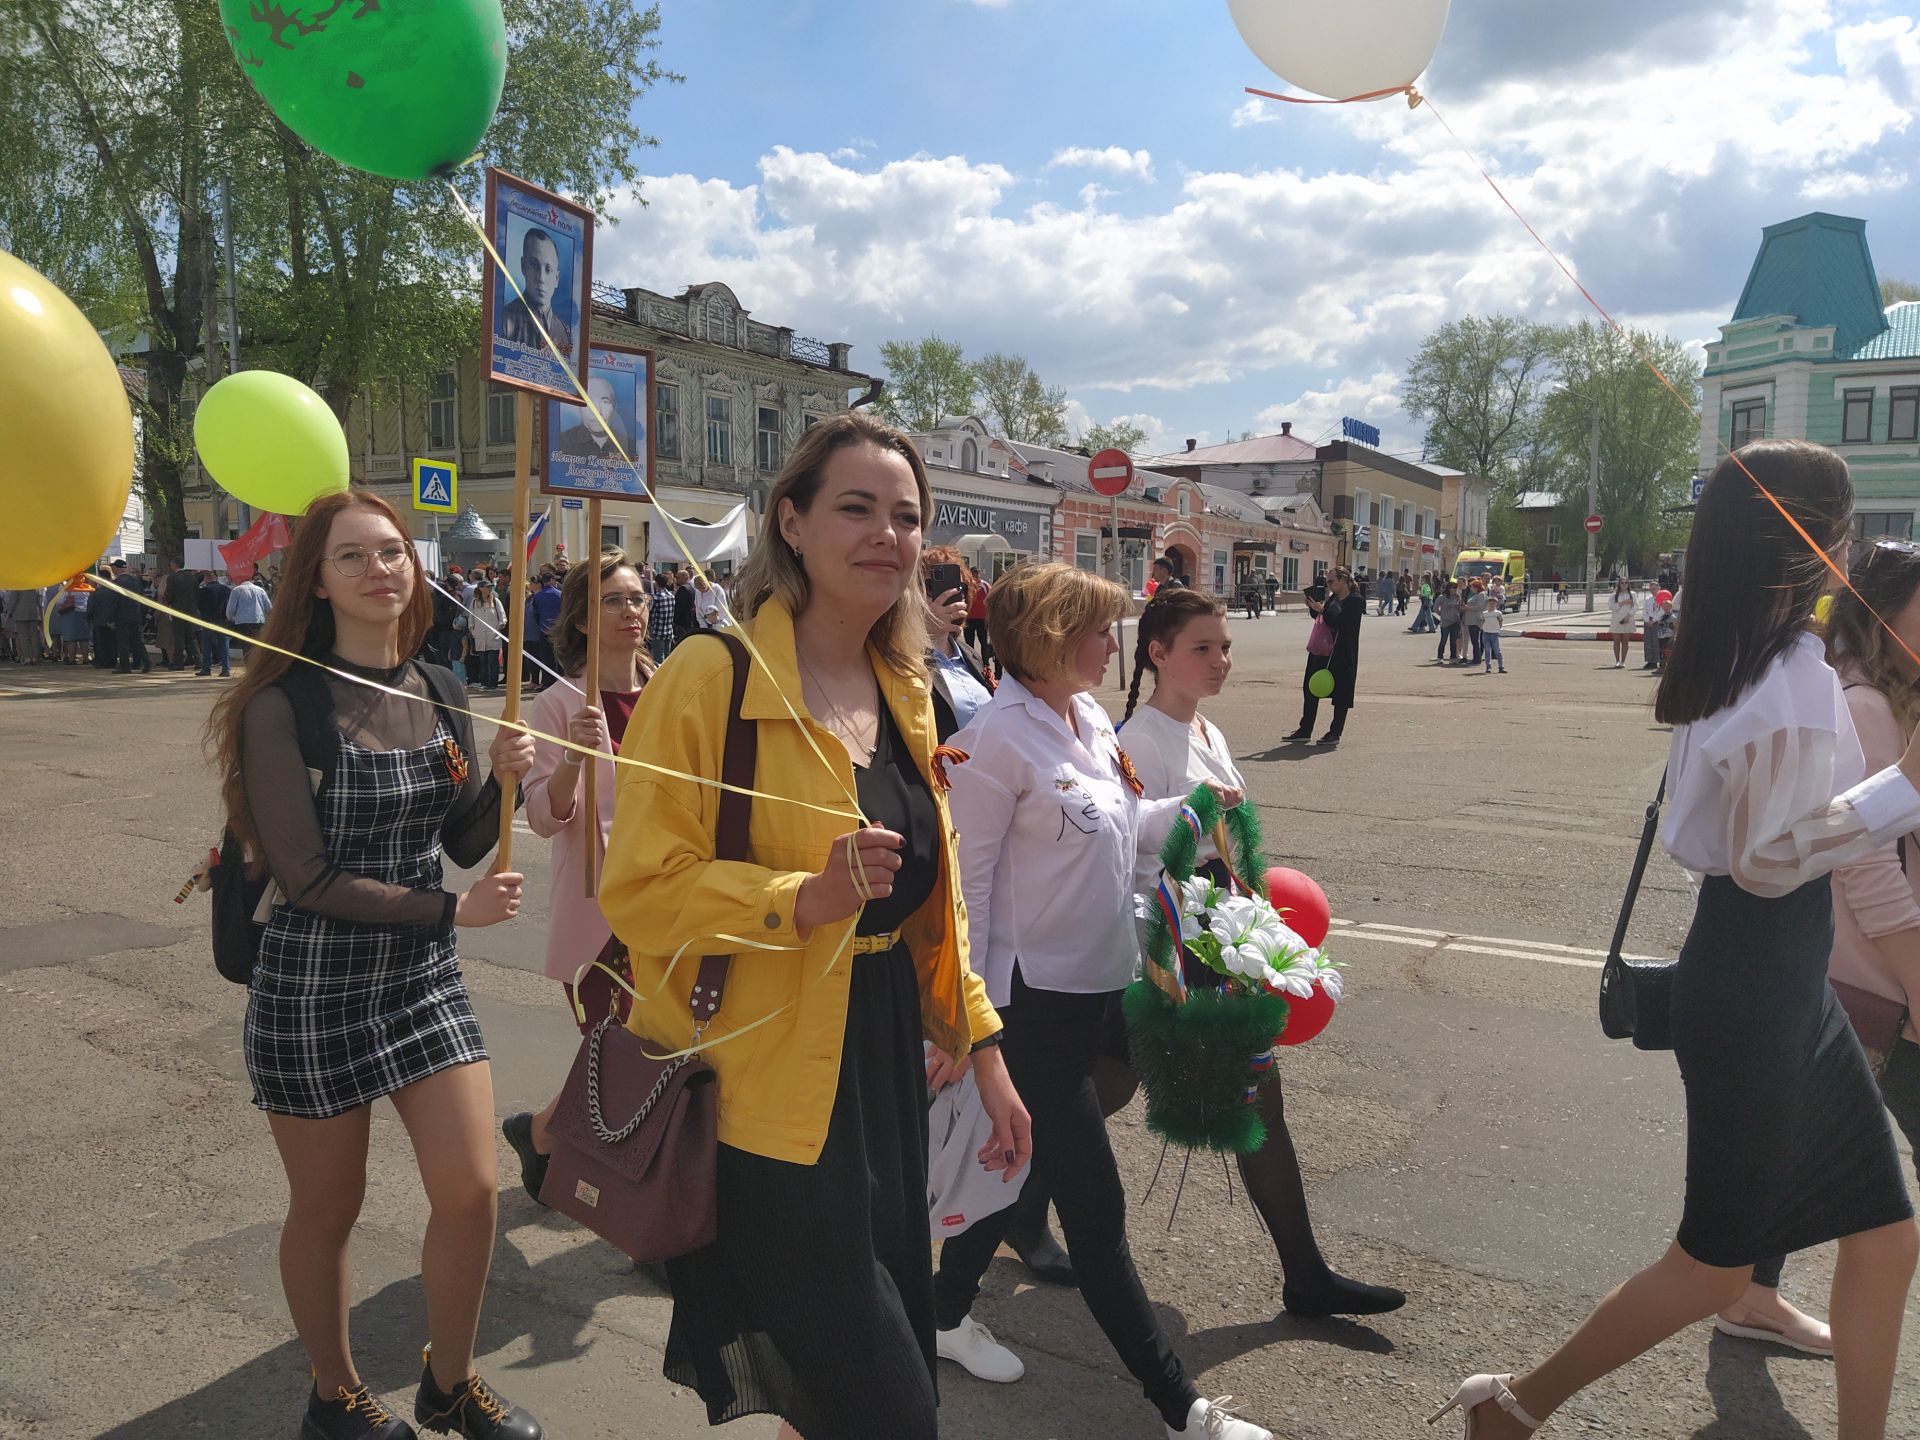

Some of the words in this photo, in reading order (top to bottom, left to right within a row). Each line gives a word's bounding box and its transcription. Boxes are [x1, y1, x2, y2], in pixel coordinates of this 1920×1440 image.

[1342, 416, 1380, 447] SAMSUNG
[551, 450, 587, 465] Петров
[587, 454, 644, 470] Константин
[565, 463, 633, 481] Александрович
[936, 503, 996, 533] AVENUE
[1003, 515, 1028, 536] кафе
